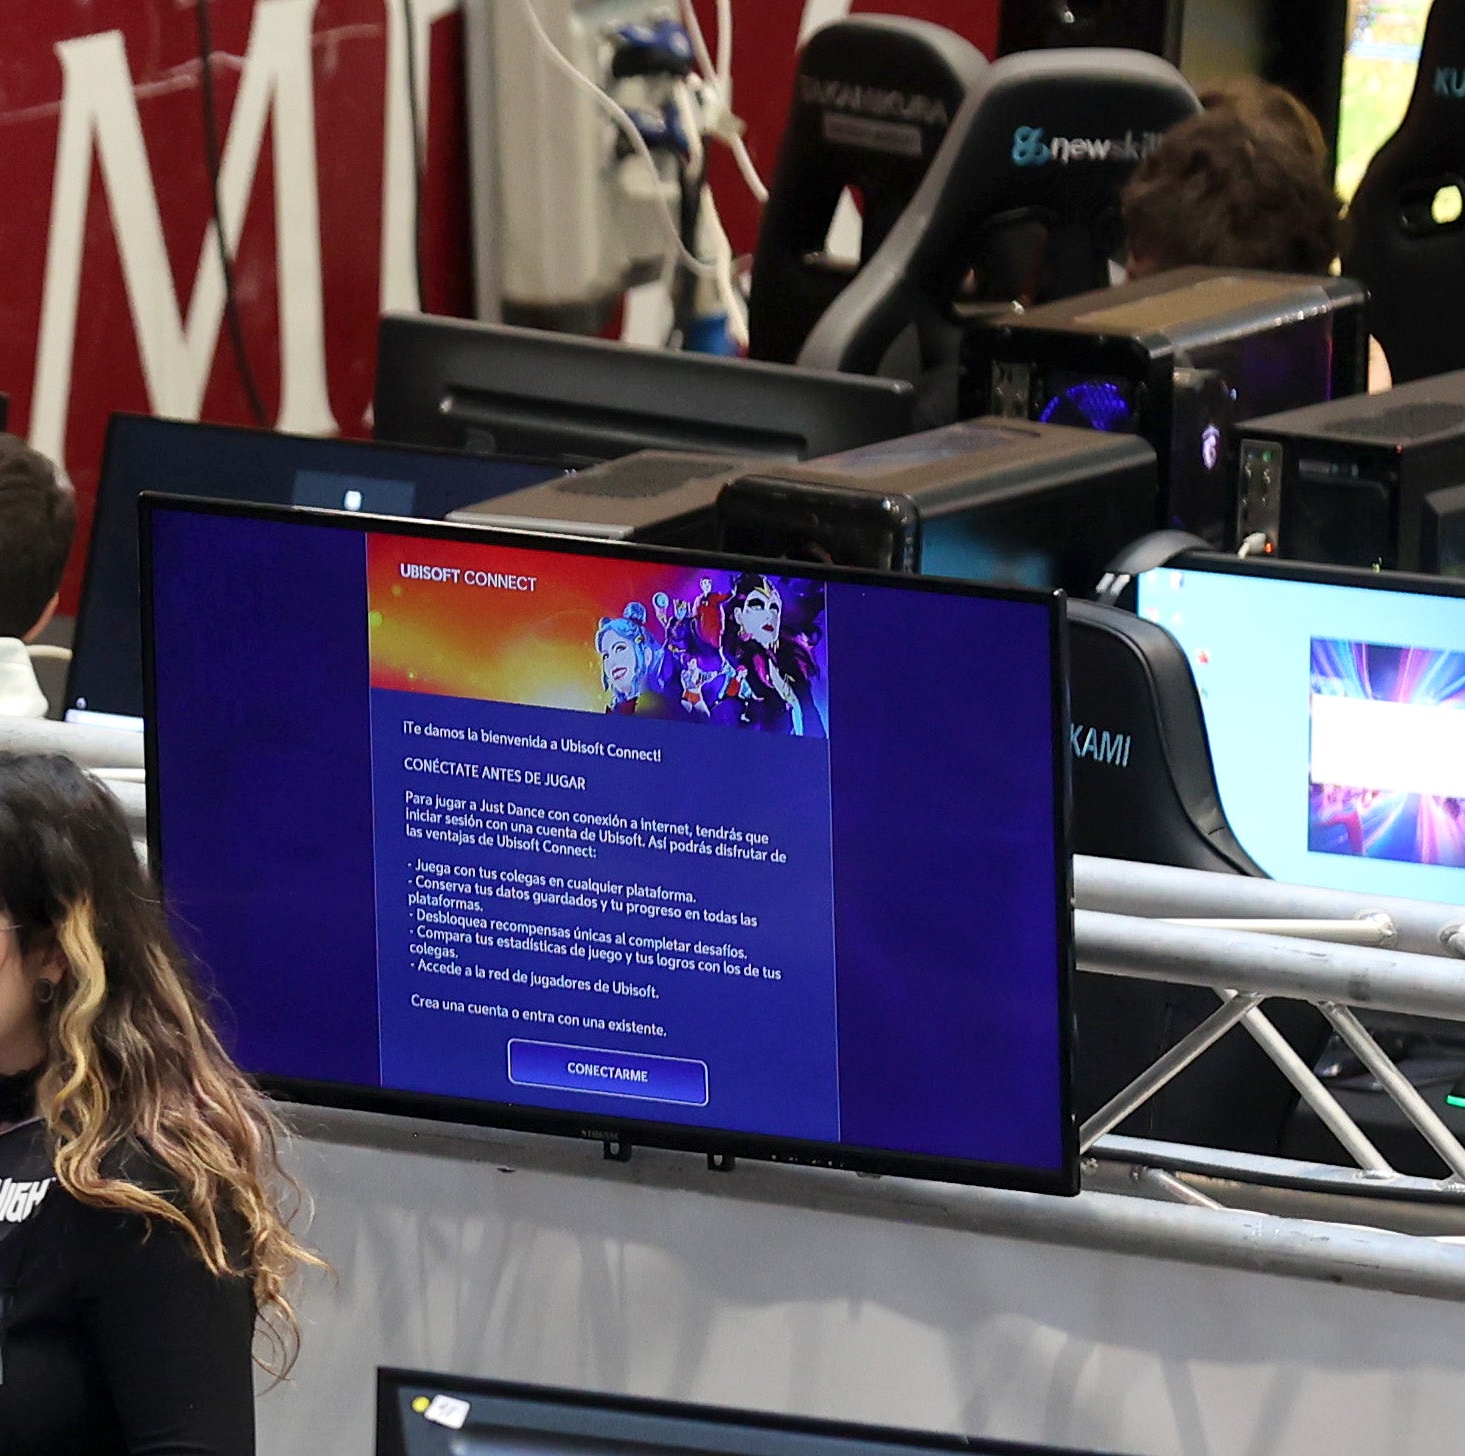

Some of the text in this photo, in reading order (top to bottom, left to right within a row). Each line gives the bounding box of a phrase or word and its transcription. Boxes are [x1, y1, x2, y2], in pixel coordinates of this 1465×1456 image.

[400, 563, 538, 592] UBISOFT CONNECT
[424, 724, 464, 739] damos
[468, 728, 477, 741] la
[481, 730, 547, 748] bienvenida
[550, 741, 557, 750] a
[561, 739, 604, 755] Ubisoft
[607, 744, 660, 762] Connect!
[404, 758, 585, 790] CONÉCTATE ANTES DE JUGAR
[406, 791, 768, 845] Para jugar a Just Dance con conexión a internet, tendrás que
[406, 824, 596, 858] las ventajas de Ubisoft Connect:
[415, 859, 695, 902] Juega con tus colegas en cualquier plataforma.
[408, 893, 483, 912] plataformas.
[415, 875, 757, 927] Conserva tus datos guardados y tu progreso en todas las
[409, 943, 457, 959] colegas.
[418, 959, 658, 998] Accede a la red de jugadores de Ubisoft.
[411, 994, 666, 1036] Crea una cuenta o entra con una existente.
[567, 1063, 647, 1082] CONECTARME
